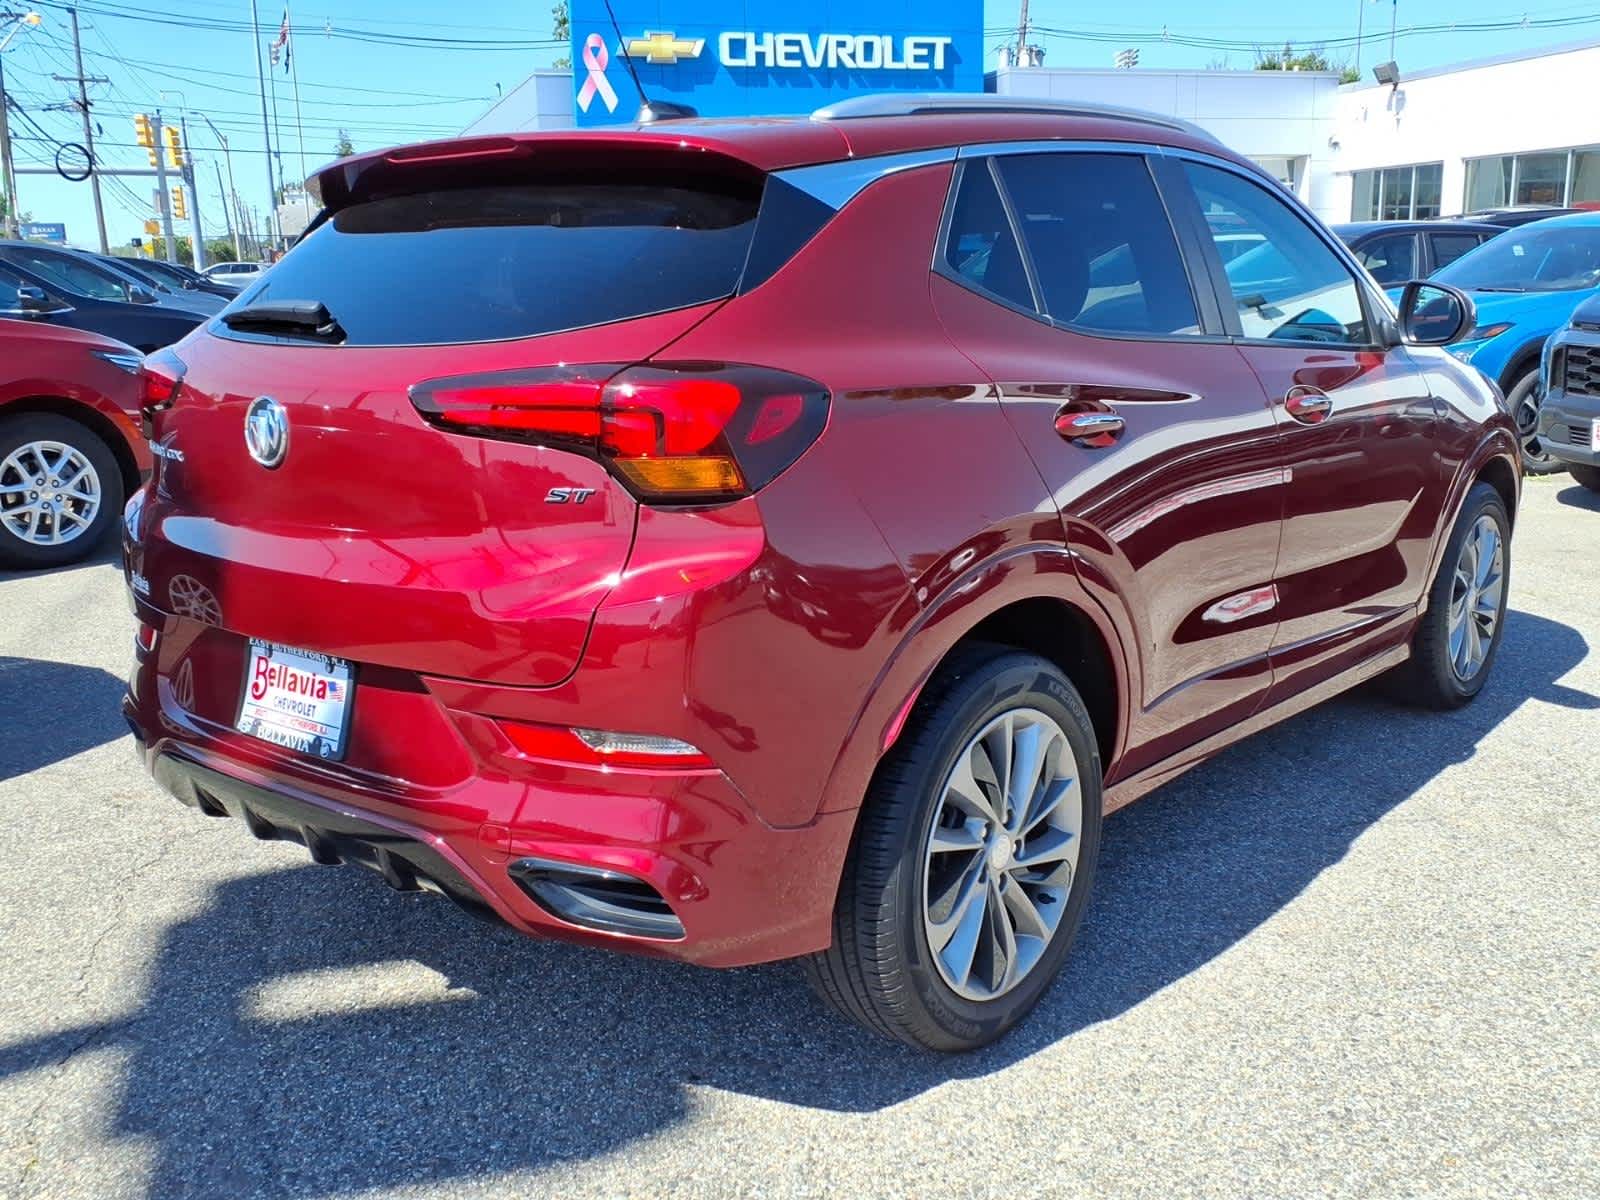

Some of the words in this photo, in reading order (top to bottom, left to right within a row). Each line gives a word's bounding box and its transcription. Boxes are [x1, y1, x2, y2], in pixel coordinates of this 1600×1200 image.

[718, 31, 952, 71] CHEVROLET
[543, 487, 596, 504] ST
[249, 637, 271, 649] EAST
[251, 656, 328, 701] Bellavia
[273, 695, 317, 718] CHEVROLET
